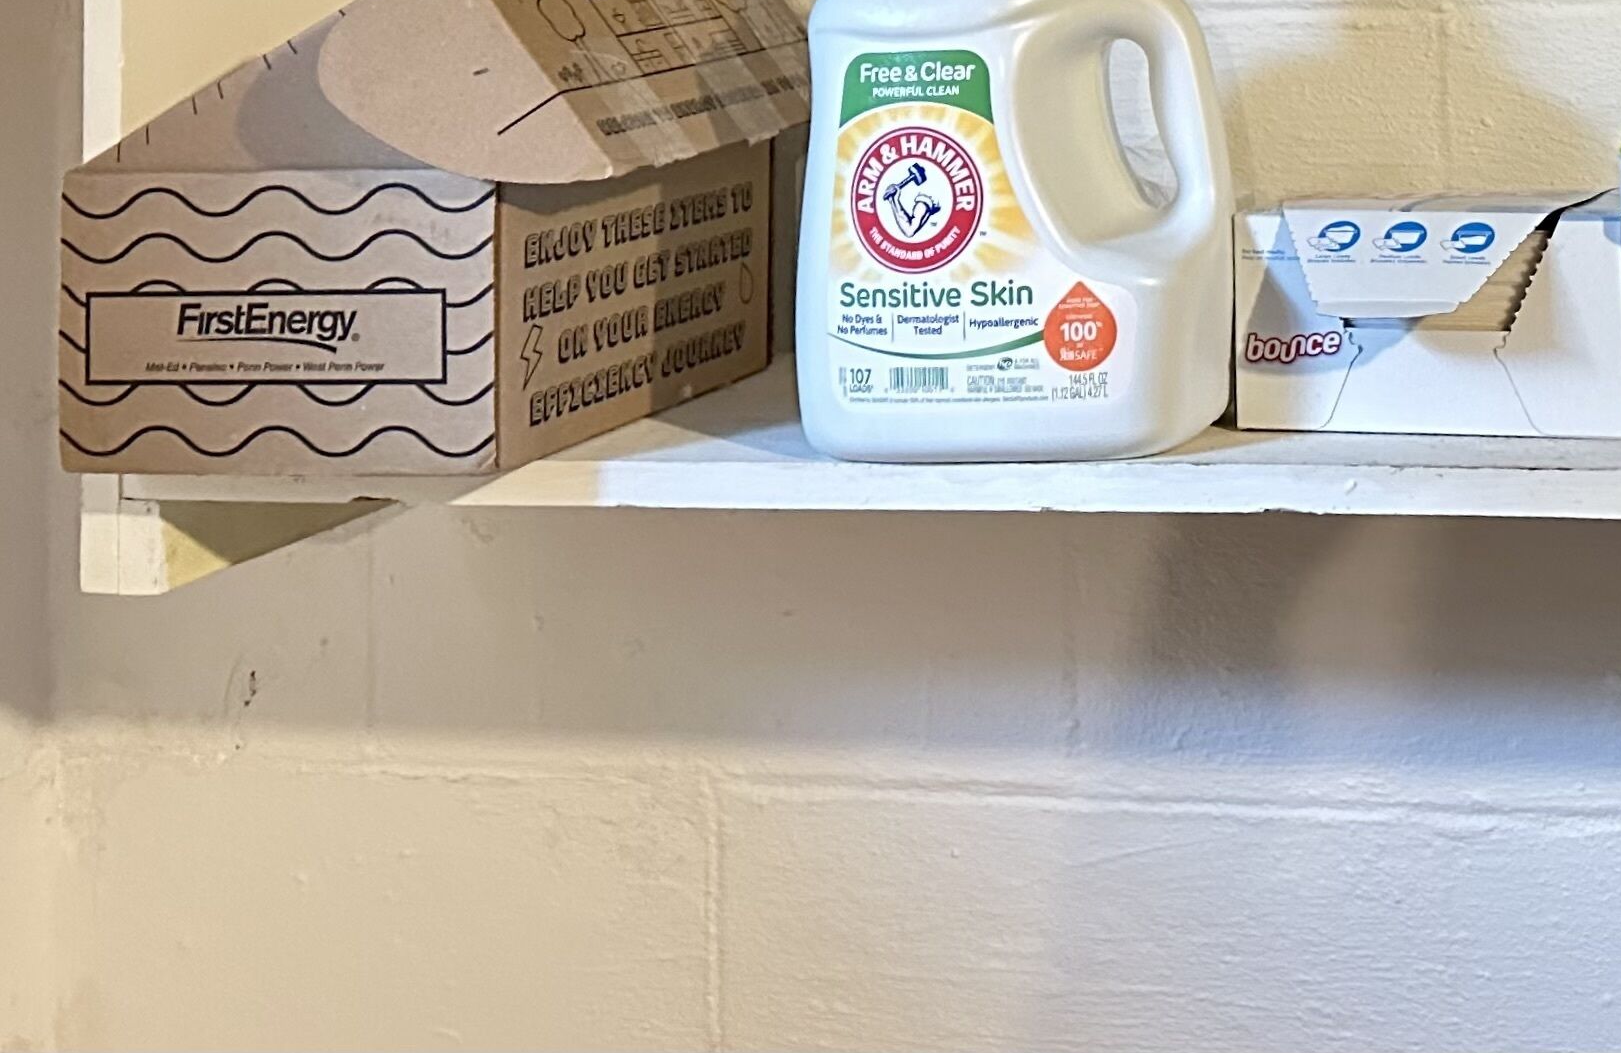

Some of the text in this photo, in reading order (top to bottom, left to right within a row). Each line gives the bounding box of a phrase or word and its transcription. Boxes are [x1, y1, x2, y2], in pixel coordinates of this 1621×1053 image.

[860, 61, 976, 83] Free & Clear
[872, 85, 960, 98] POWERFUL CLEAN
[857, 134, 976, 214] ARM & HAMMER
[524, 219, 597, 269] ENJOY
[601, 201, 665, 248] THESE
[731, 181, 754, 214] TO
[523, 227, 754, 323] HELP YOU GET STARTED
[839, 279, 1034, 308] Sensitive Skin
[176, 301, 357, 342] FirstEnergy
[837, 325, 887, 335] No Perfumes
[842, 314, 853, 323] No
[855, 314, 874, 325] Dyes
[897, 314, 959, 326] Dermatologist
[913, 325, 943, 335] Tested
[969, 317, 1039, 330] Hypoallergenic
[558, 324, 589, 364] ON
[593, 304, 650, 352] YOUR
[1245, 330, 1342, 364] bounce
[529, 350, 657, 427] EFFICIENCY
[850, 368, 871, 385] 107
